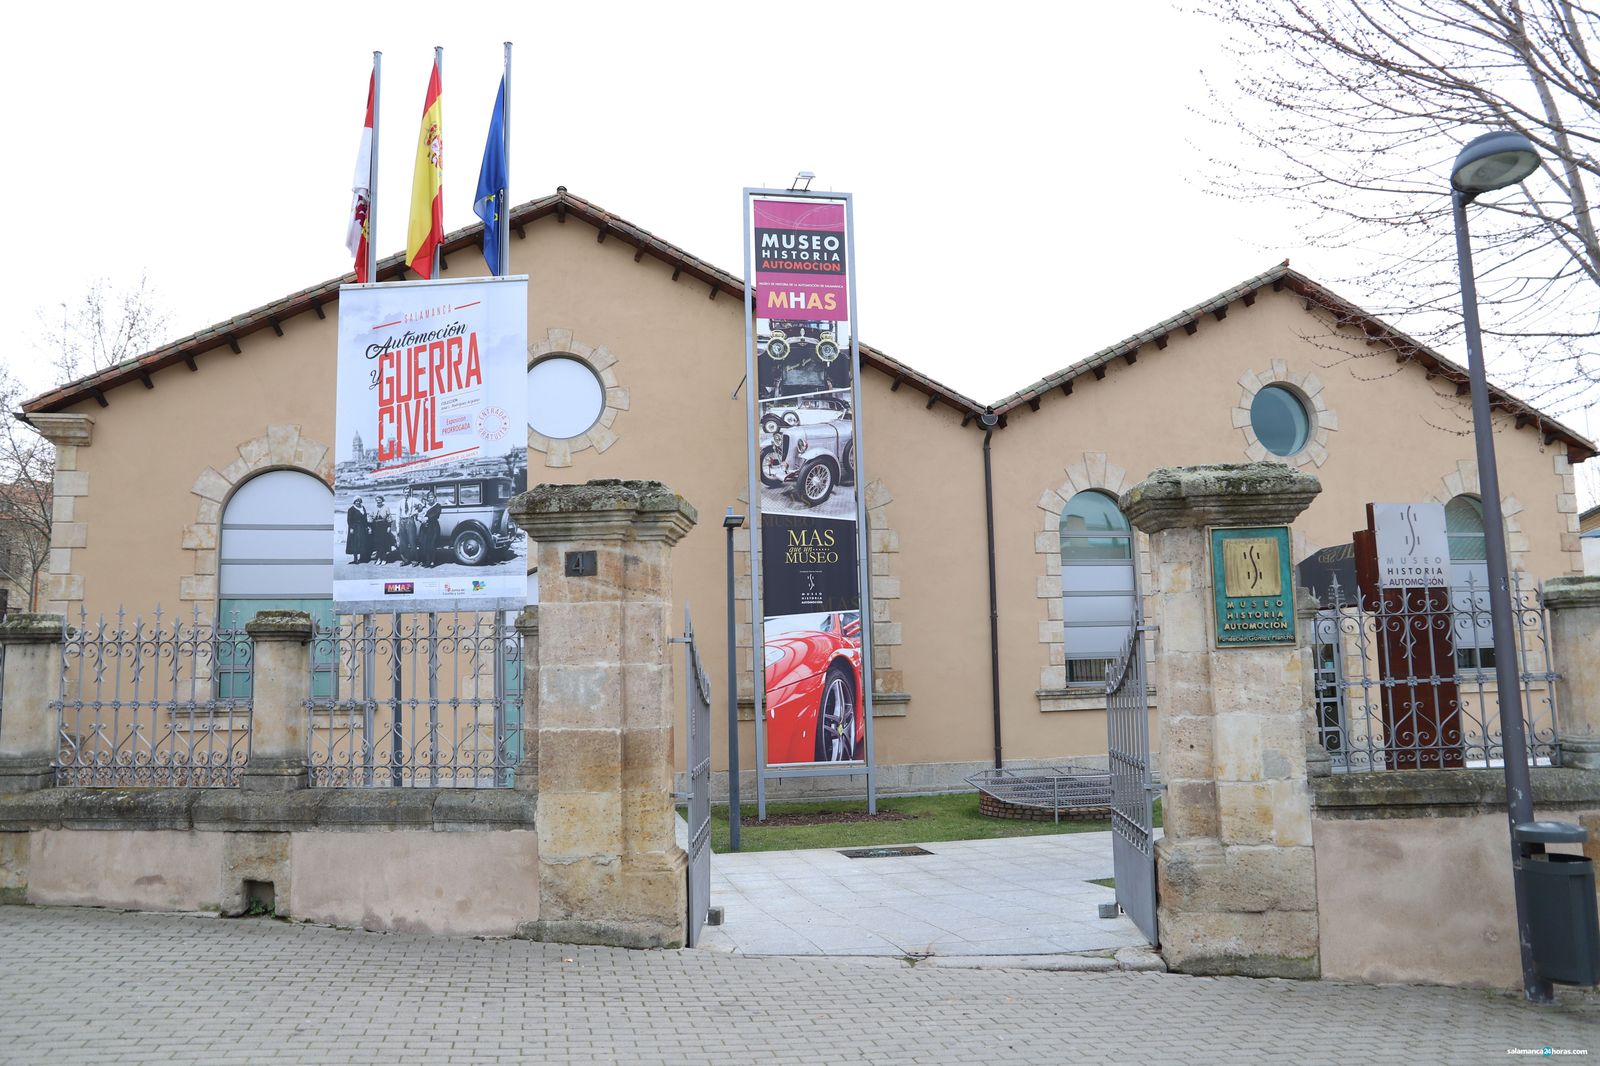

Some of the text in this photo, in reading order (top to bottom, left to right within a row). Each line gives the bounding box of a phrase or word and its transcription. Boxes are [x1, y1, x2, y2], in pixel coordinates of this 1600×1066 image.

[761, 233, 840, 251] MUSEO
[762, 249, 840, 261] HISTORIA
[762, 260, 841, 271] AUTOMOCION
[767, 291, 837, 311] MHAS
[404, 304, 452, 323] SALAMANCA
[365, 321, 467, 359] Automoción
[378, 332, 482, 407] GUERRA
[479, 408, 507, 420] ENTRADA
[378, 396, 443, 461] CIVIL
[787, 529, 835, 547] MAS
[572, 552, 585, 575] 4
[785, 551, 839, 564] MUSEO
[1386, 557, 1442, 565] MUSEO
[1387, 567, 1443, 575] HISTORIA
[1226, 600, 1283, 609] MUSEO
[1227, 611, 1284, 620] HISTORIA
[1224, 618, 1288, 630] AUTOMOCIÓN
